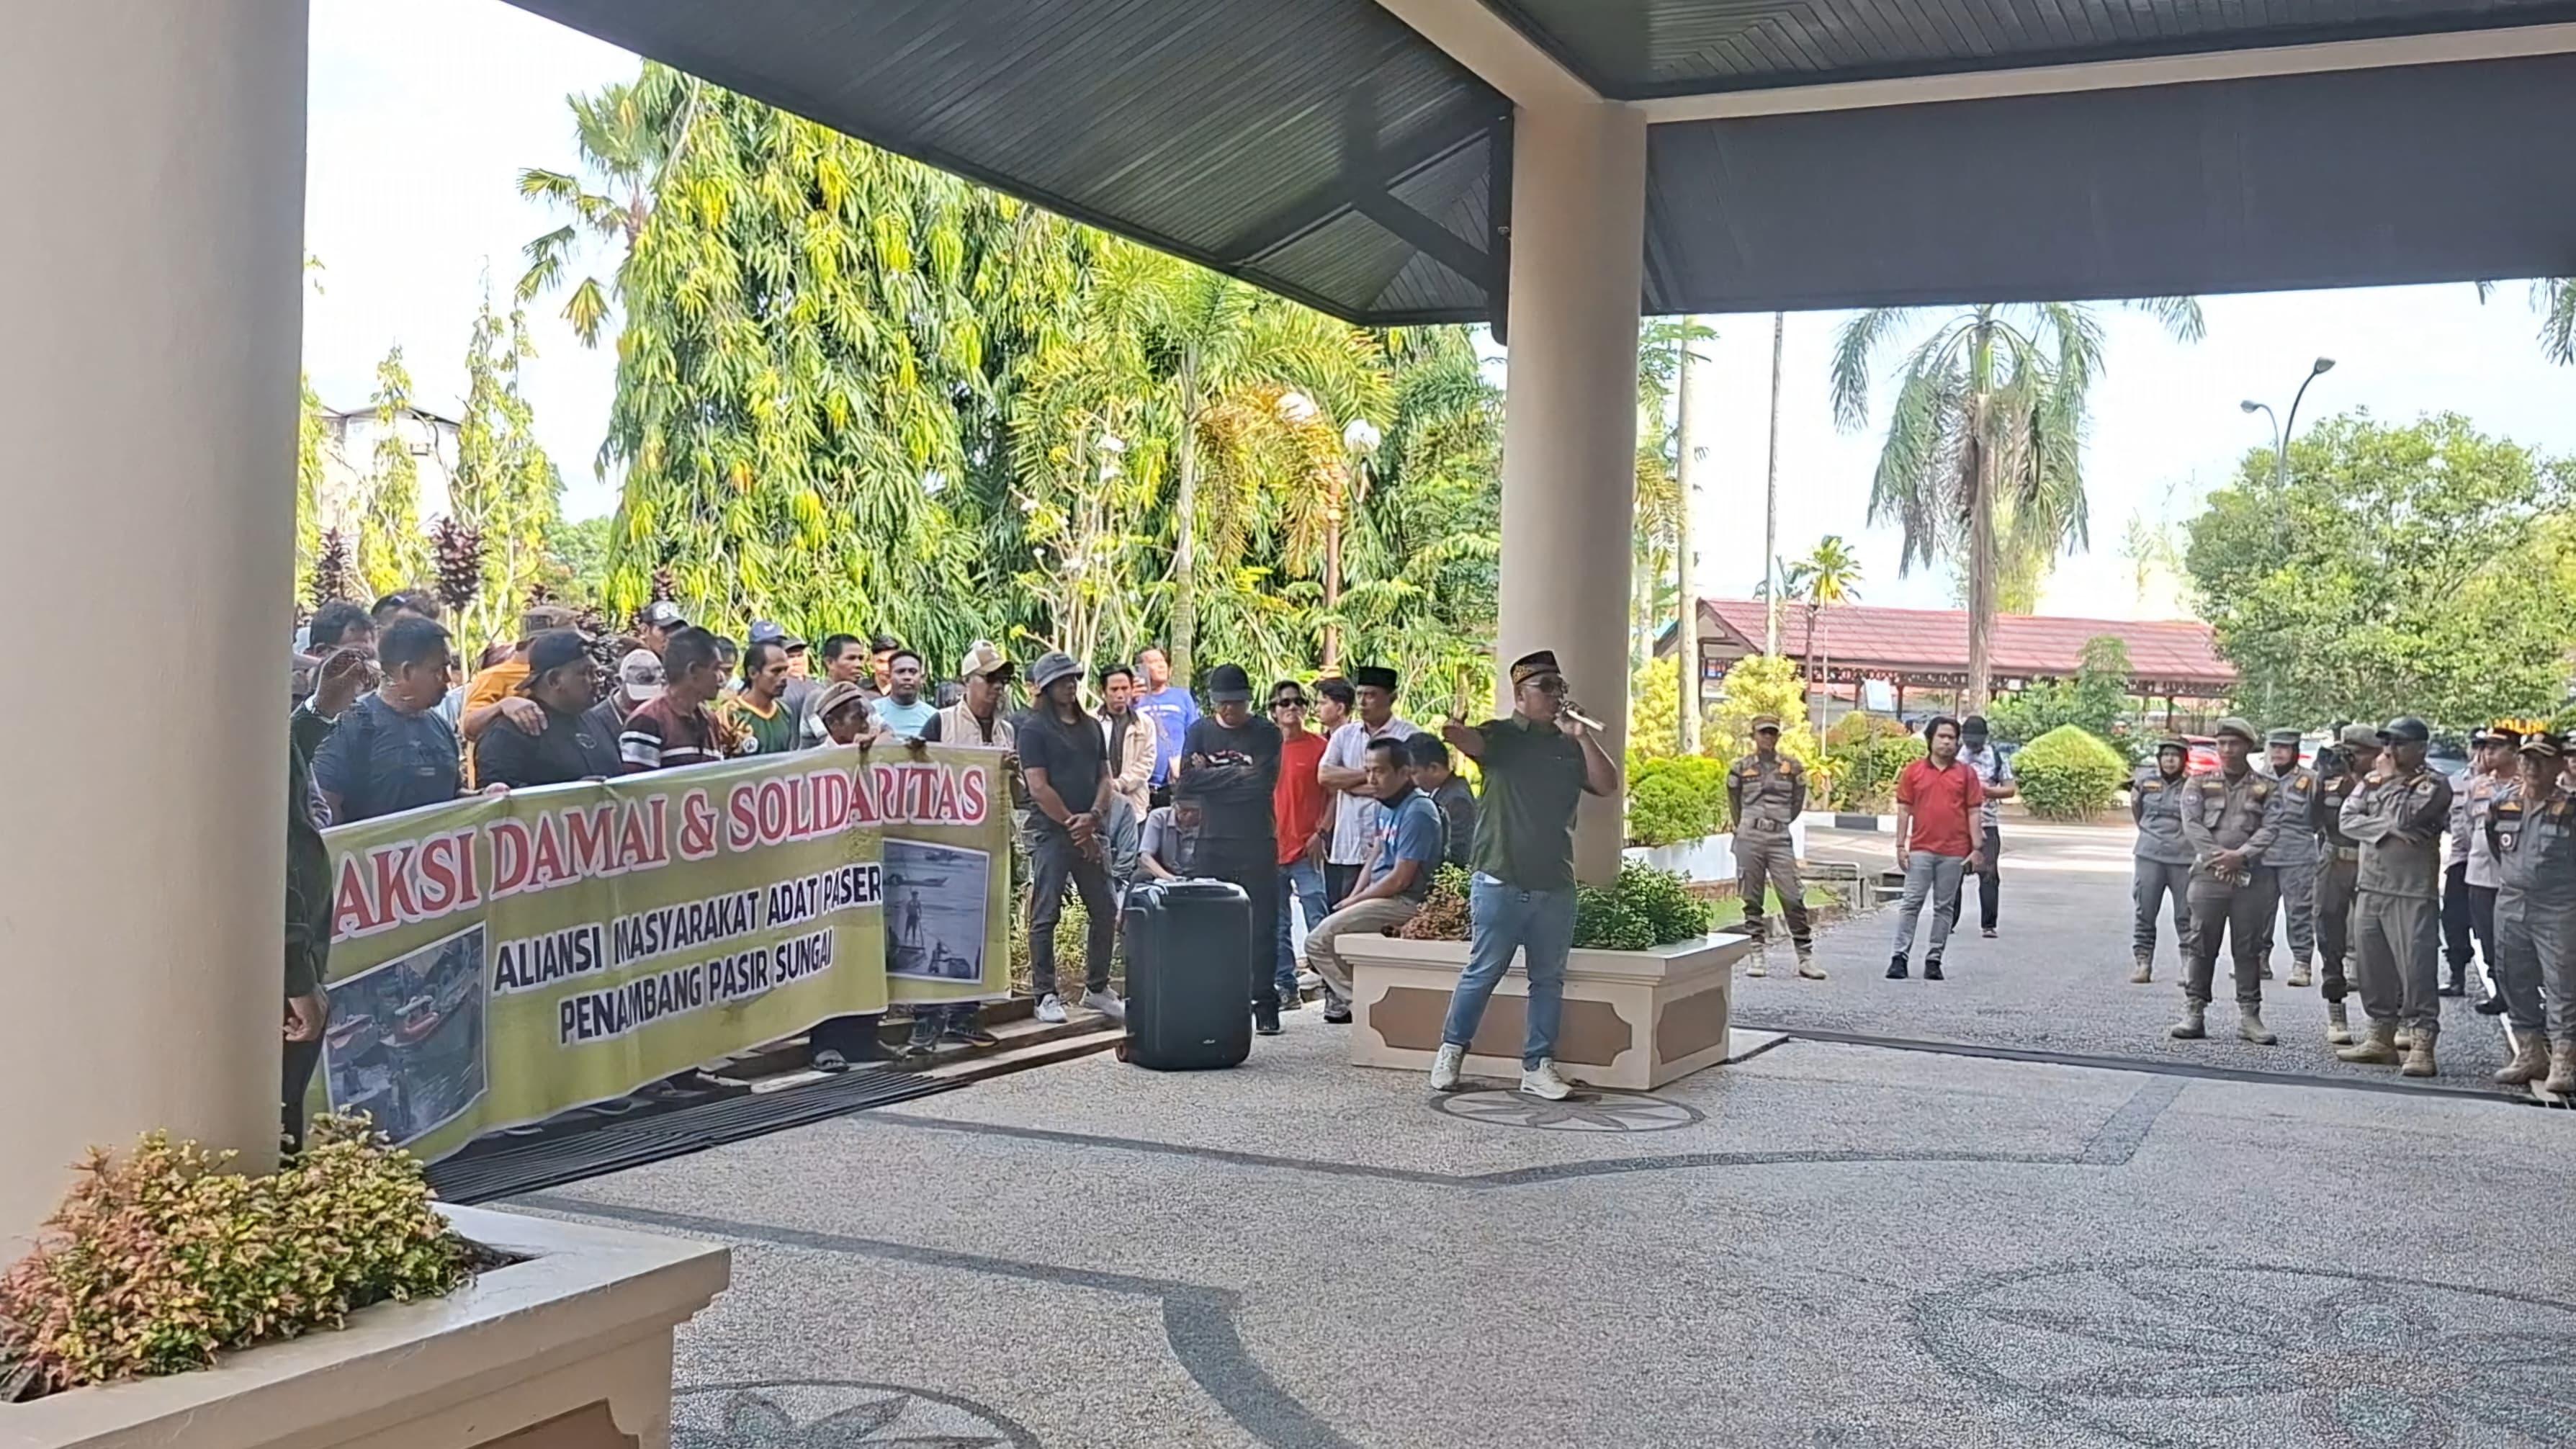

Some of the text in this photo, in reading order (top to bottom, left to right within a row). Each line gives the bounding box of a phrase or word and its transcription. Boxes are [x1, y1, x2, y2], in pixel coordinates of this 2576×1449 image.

[331, 767, 986, 936] AKSI DAMAI & SOLIDARITAS
[493, 865, 882, 992] ALIANSI MASYARAKAT ADAT PASER
[560, 929, 833, 1045] PENAMBANG PASIR SUNGAI
